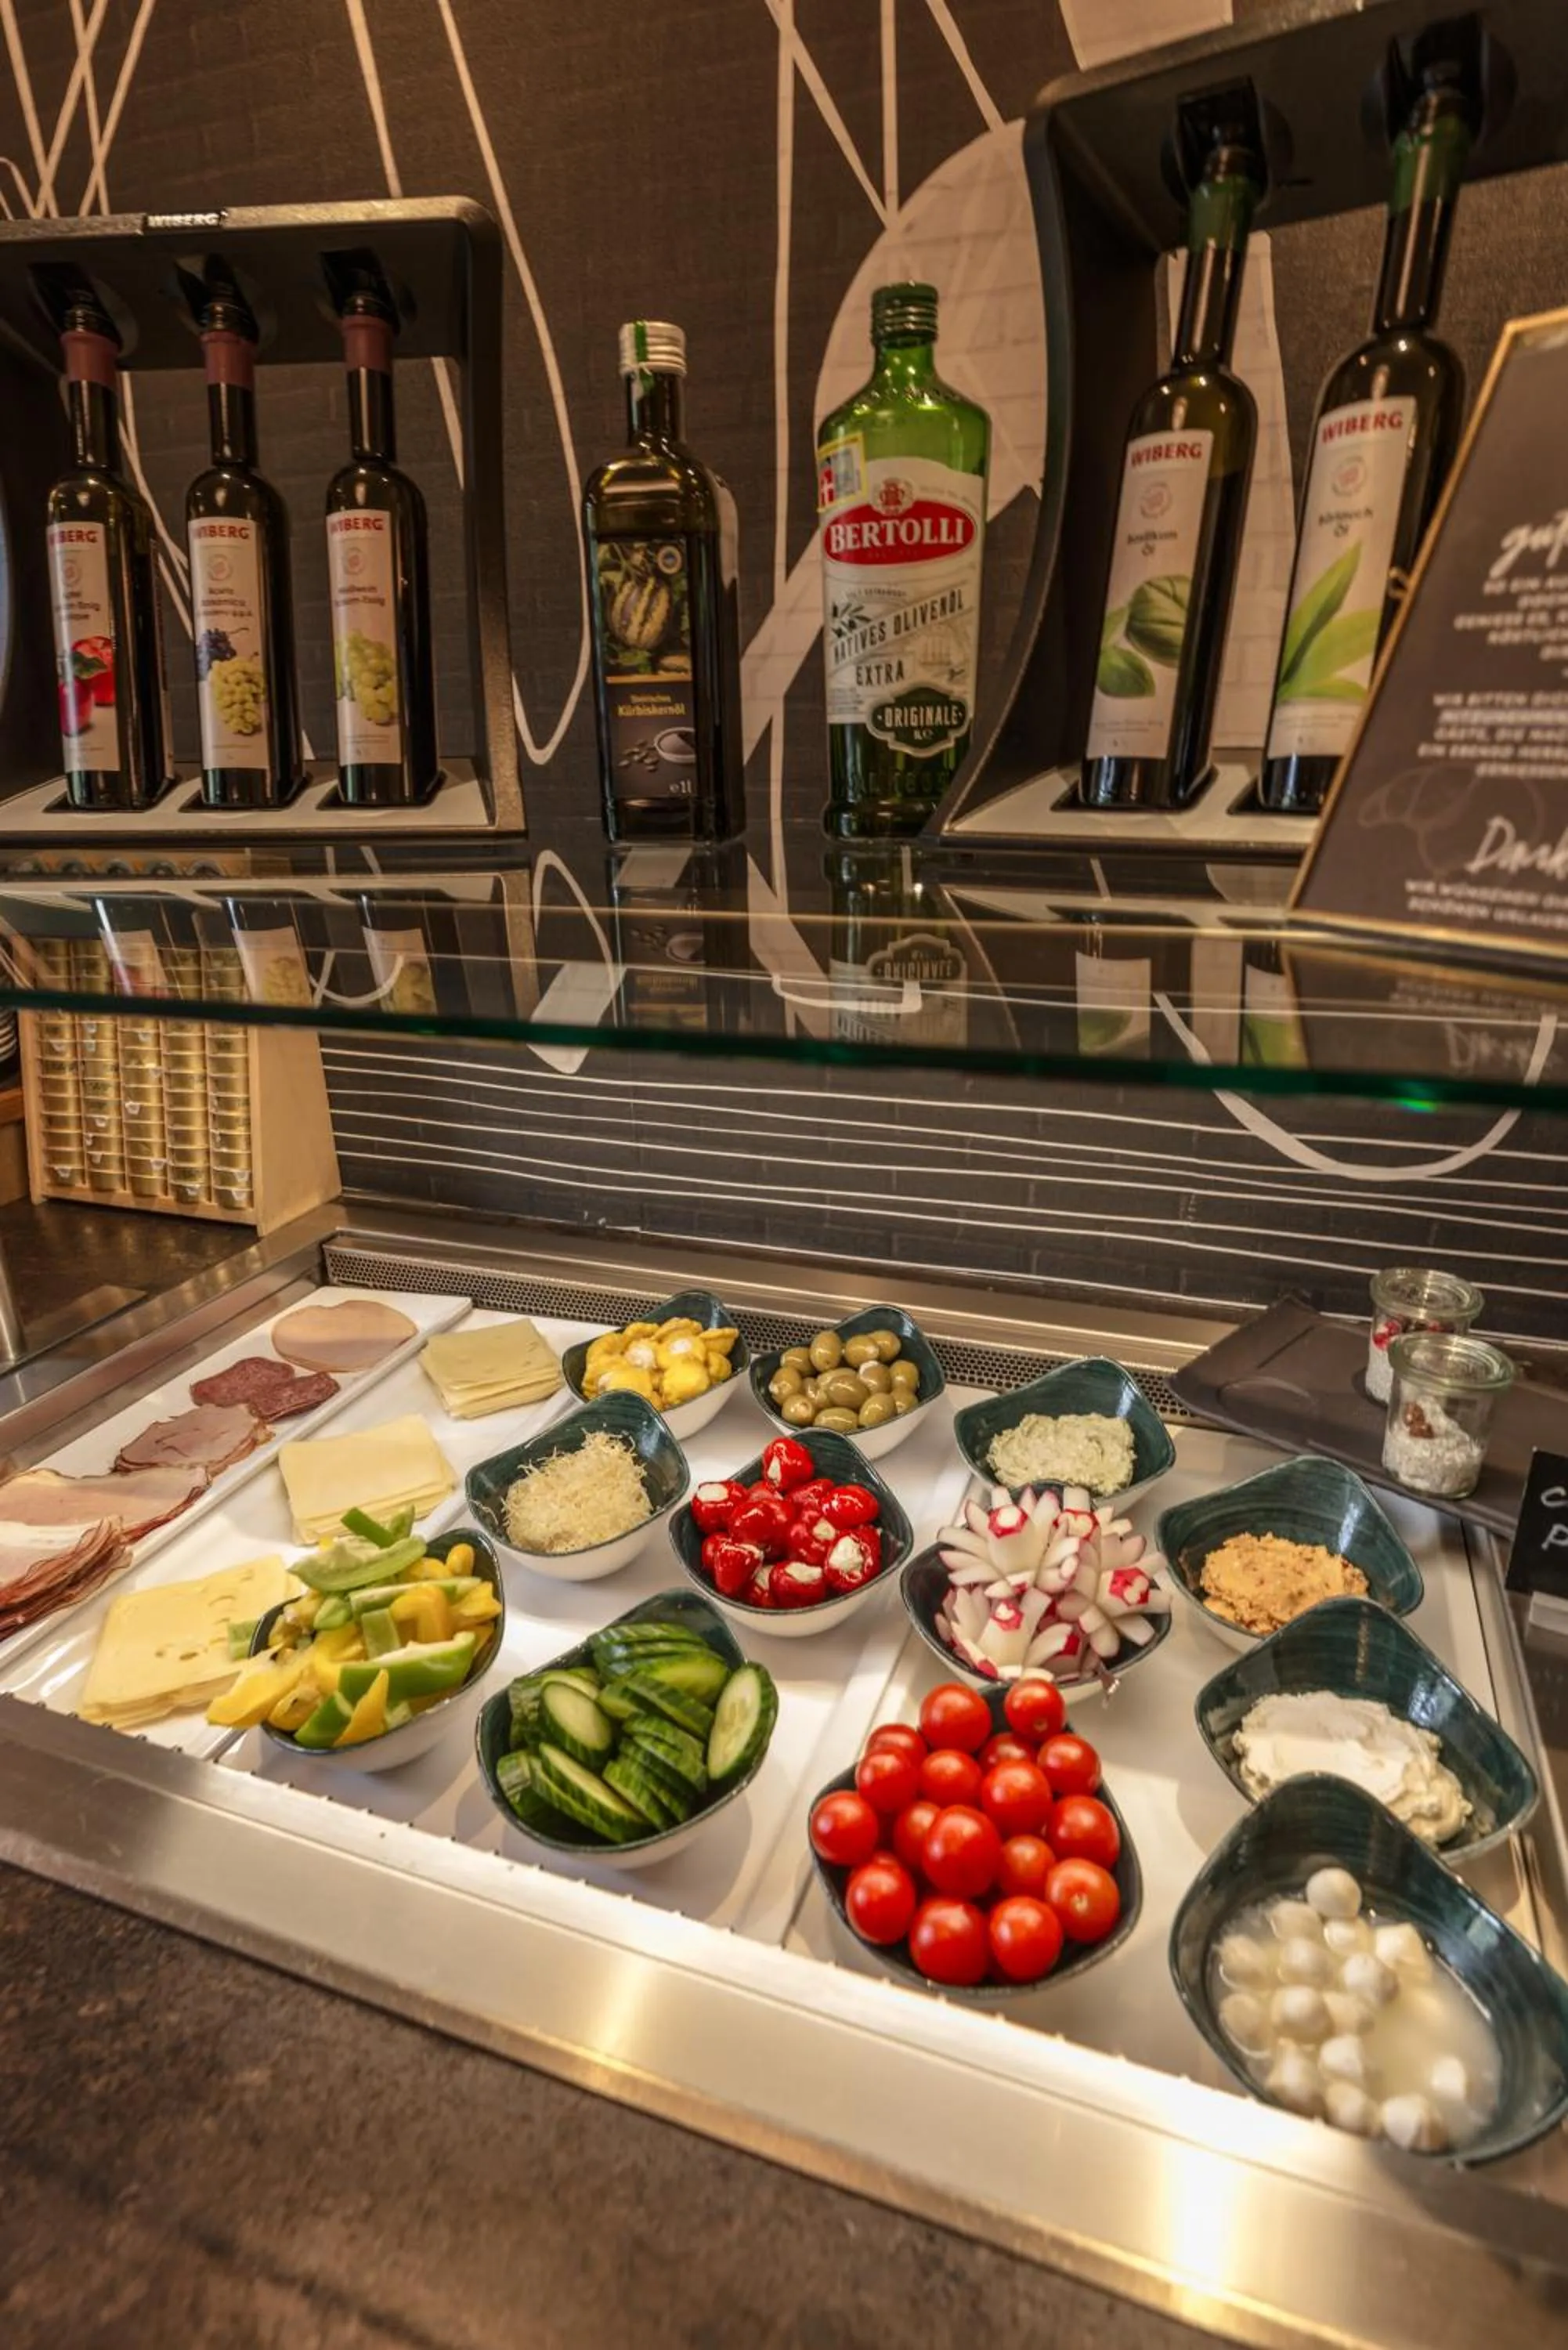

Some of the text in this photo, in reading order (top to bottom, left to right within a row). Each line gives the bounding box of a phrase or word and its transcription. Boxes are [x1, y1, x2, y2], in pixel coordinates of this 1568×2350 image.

[1321, 410, 1404, 444] WIBERG
[1131, 442, 1203, 468] WIBERG
[829, 517, 966, 554] BERTOLLI
[833, 620, 887, 665] NATIVES
[856, 660, 905, 687] EXTRA
[884, 706, 959, 728] ORIGINALE
